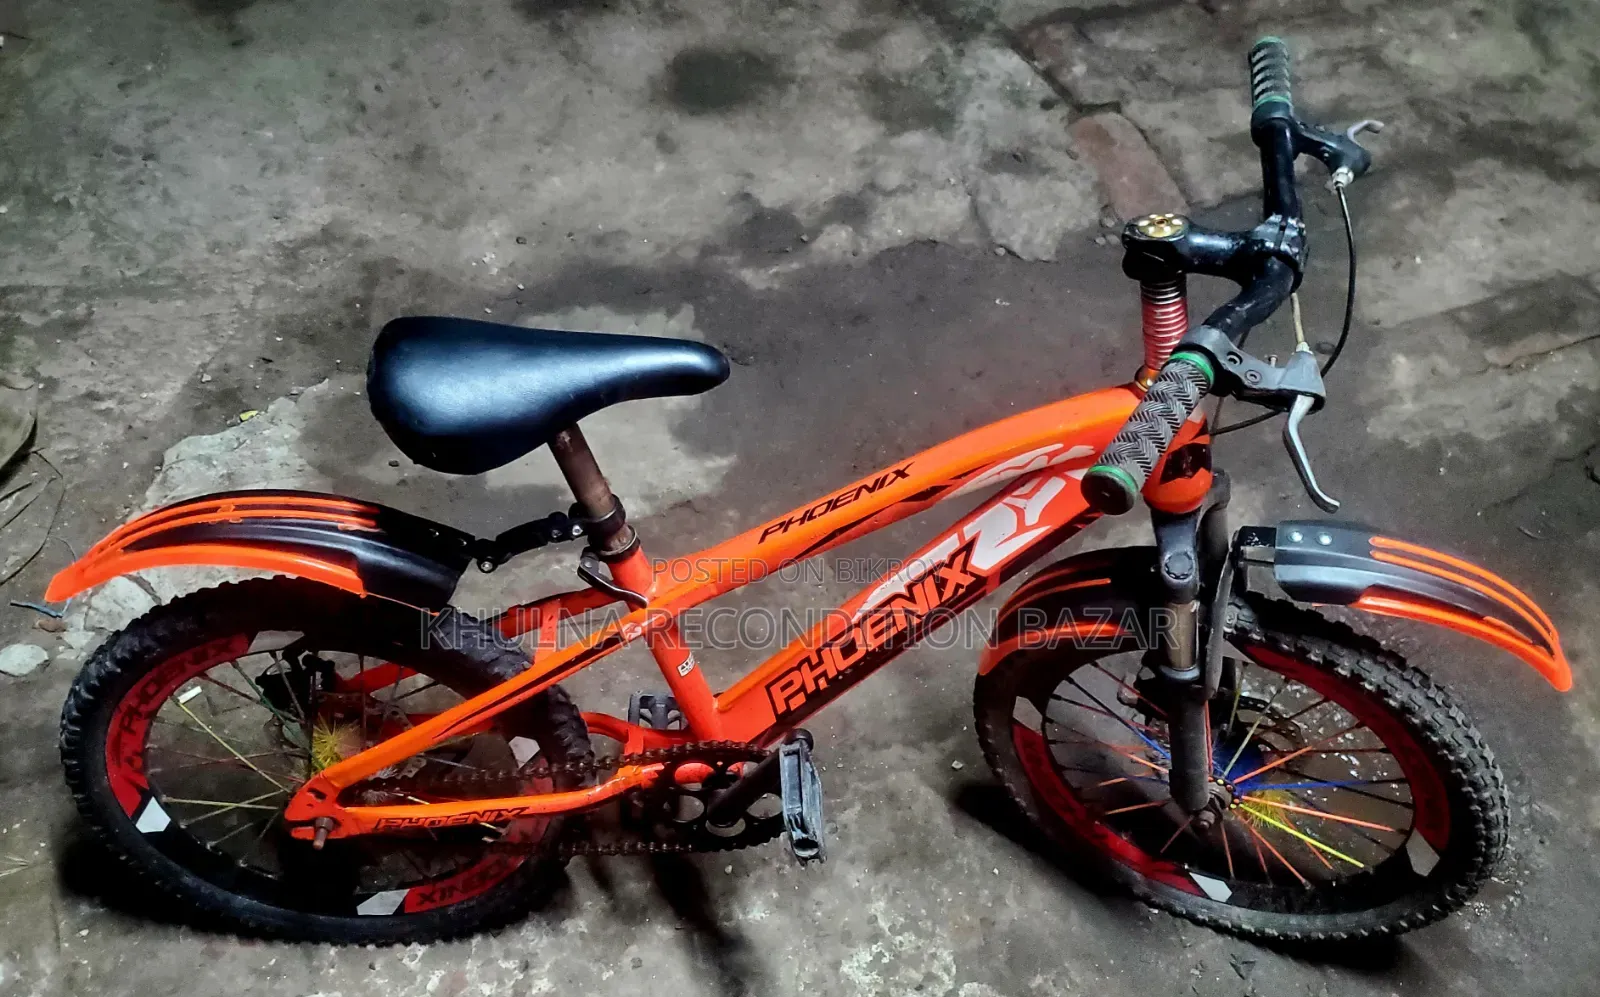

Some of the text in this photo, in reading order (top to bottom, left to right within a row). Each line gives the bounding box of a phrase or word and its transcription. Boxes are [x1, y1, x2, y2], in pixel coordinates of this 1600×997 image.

[758, 462, 915, 544] PHOENIX
[767, 543, 981, 716] PHOENIX
[374, 806, 530, 831] PHOENIX
